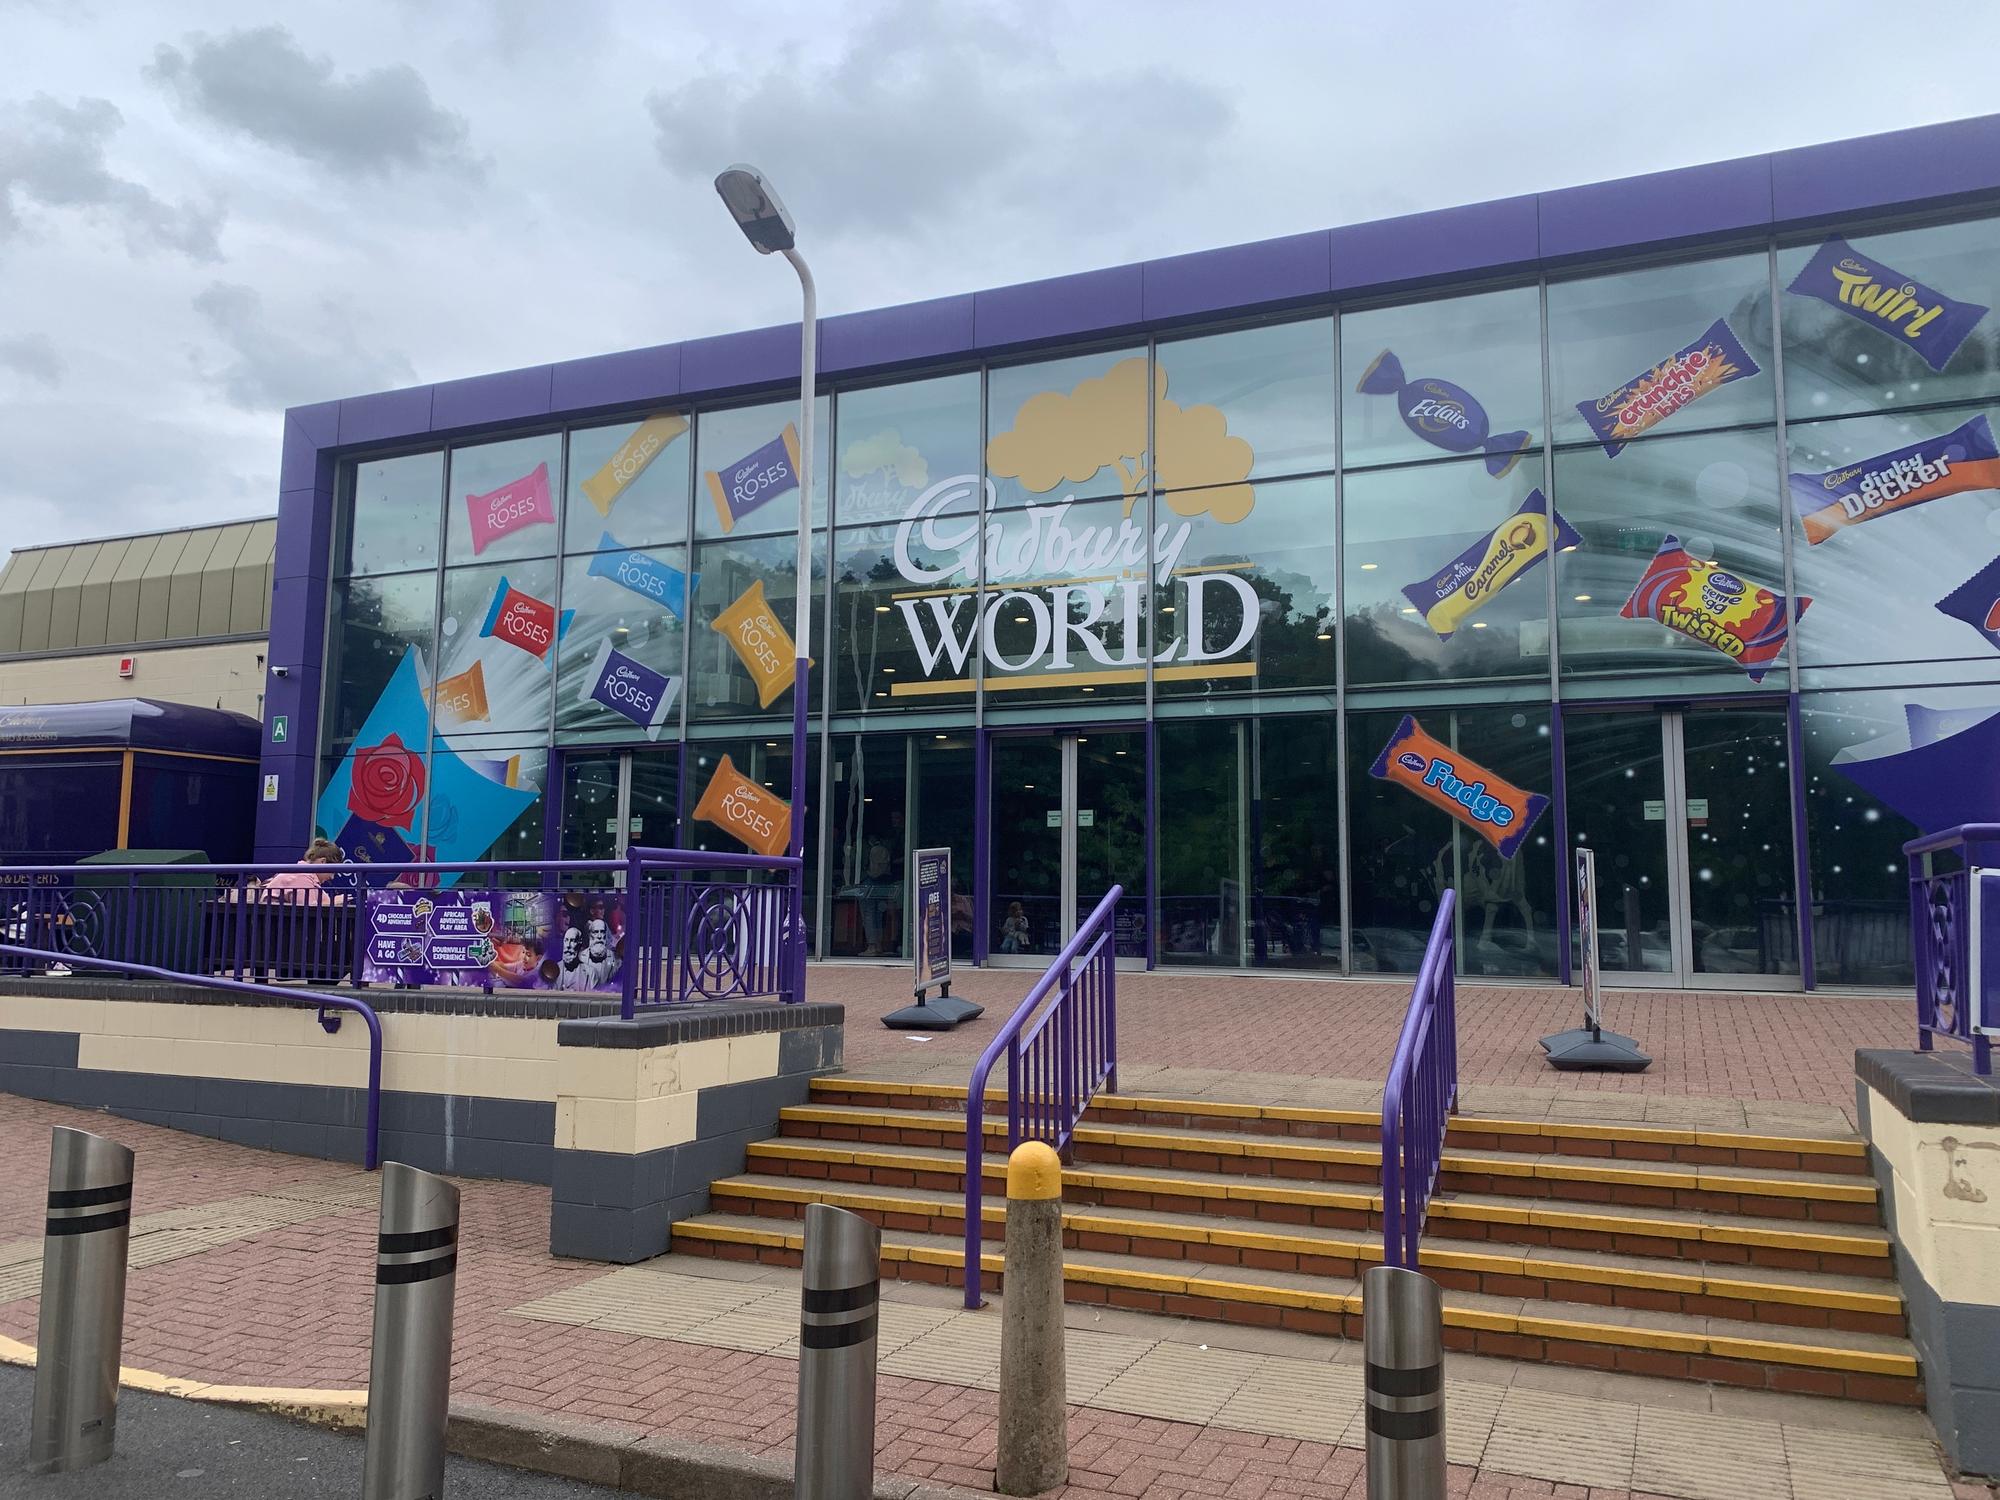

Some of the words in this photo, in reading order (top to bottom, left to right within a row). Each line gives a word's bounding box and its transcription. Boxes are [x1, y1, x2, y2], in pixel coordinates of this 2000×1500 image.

[1832, 264, 1945, 339] Twirl
[1618, 351, 1709, 427] crunchie
[1654, 386, 1696, 419] bits
[1408, 399, 1470, 430] Eclairs
[614, 434, 659, 485] ROSES
[1860, 453, 1924, 492] dinky
[733, 461, 788, 504] ROSES
[1823, 467, 1863, 490] Cadbury
[1839, 454, 1952, 519] Decker
[487, 497, 535, 529] ROSES
[893, 473, 1192, 587] Cadbury
[617, 562, 666, 596] ROSES
[1464, 539, 1512, 601] Caramel
[1709, 573, 1742, 593] Cadbury
[1435, 577, 1459, 599] Dairy
[1701, 584, 1743, 605] creme
[1701, 594, 1728, 615] egg
[503, 611, 549, 644] ROSES
[893, 572, 1260, 678] WORLD
[1660, 604, 1746, 658] TWISTED
[738, 618, 780, 675] ROSES
[616, 665, 641, 682] Cadbury
[604, 674, 653, 712] ROSES
[274, 722, 285, 737] A
[1423, 758, 1514, 827] Fudge
[721, 793, 774, 837] ROSES
[13, 873, 60, 884] DEERTS
[376, 913, 388, 924] 4D
[377, 940, 396, 949] HAVE
[377, 950, 383, 958] A
[385, 950, 395, 959] GO
[432, 946, 466, 954] BOURNVILLE
[433, 953, 466, 961] EXPERIENCE
